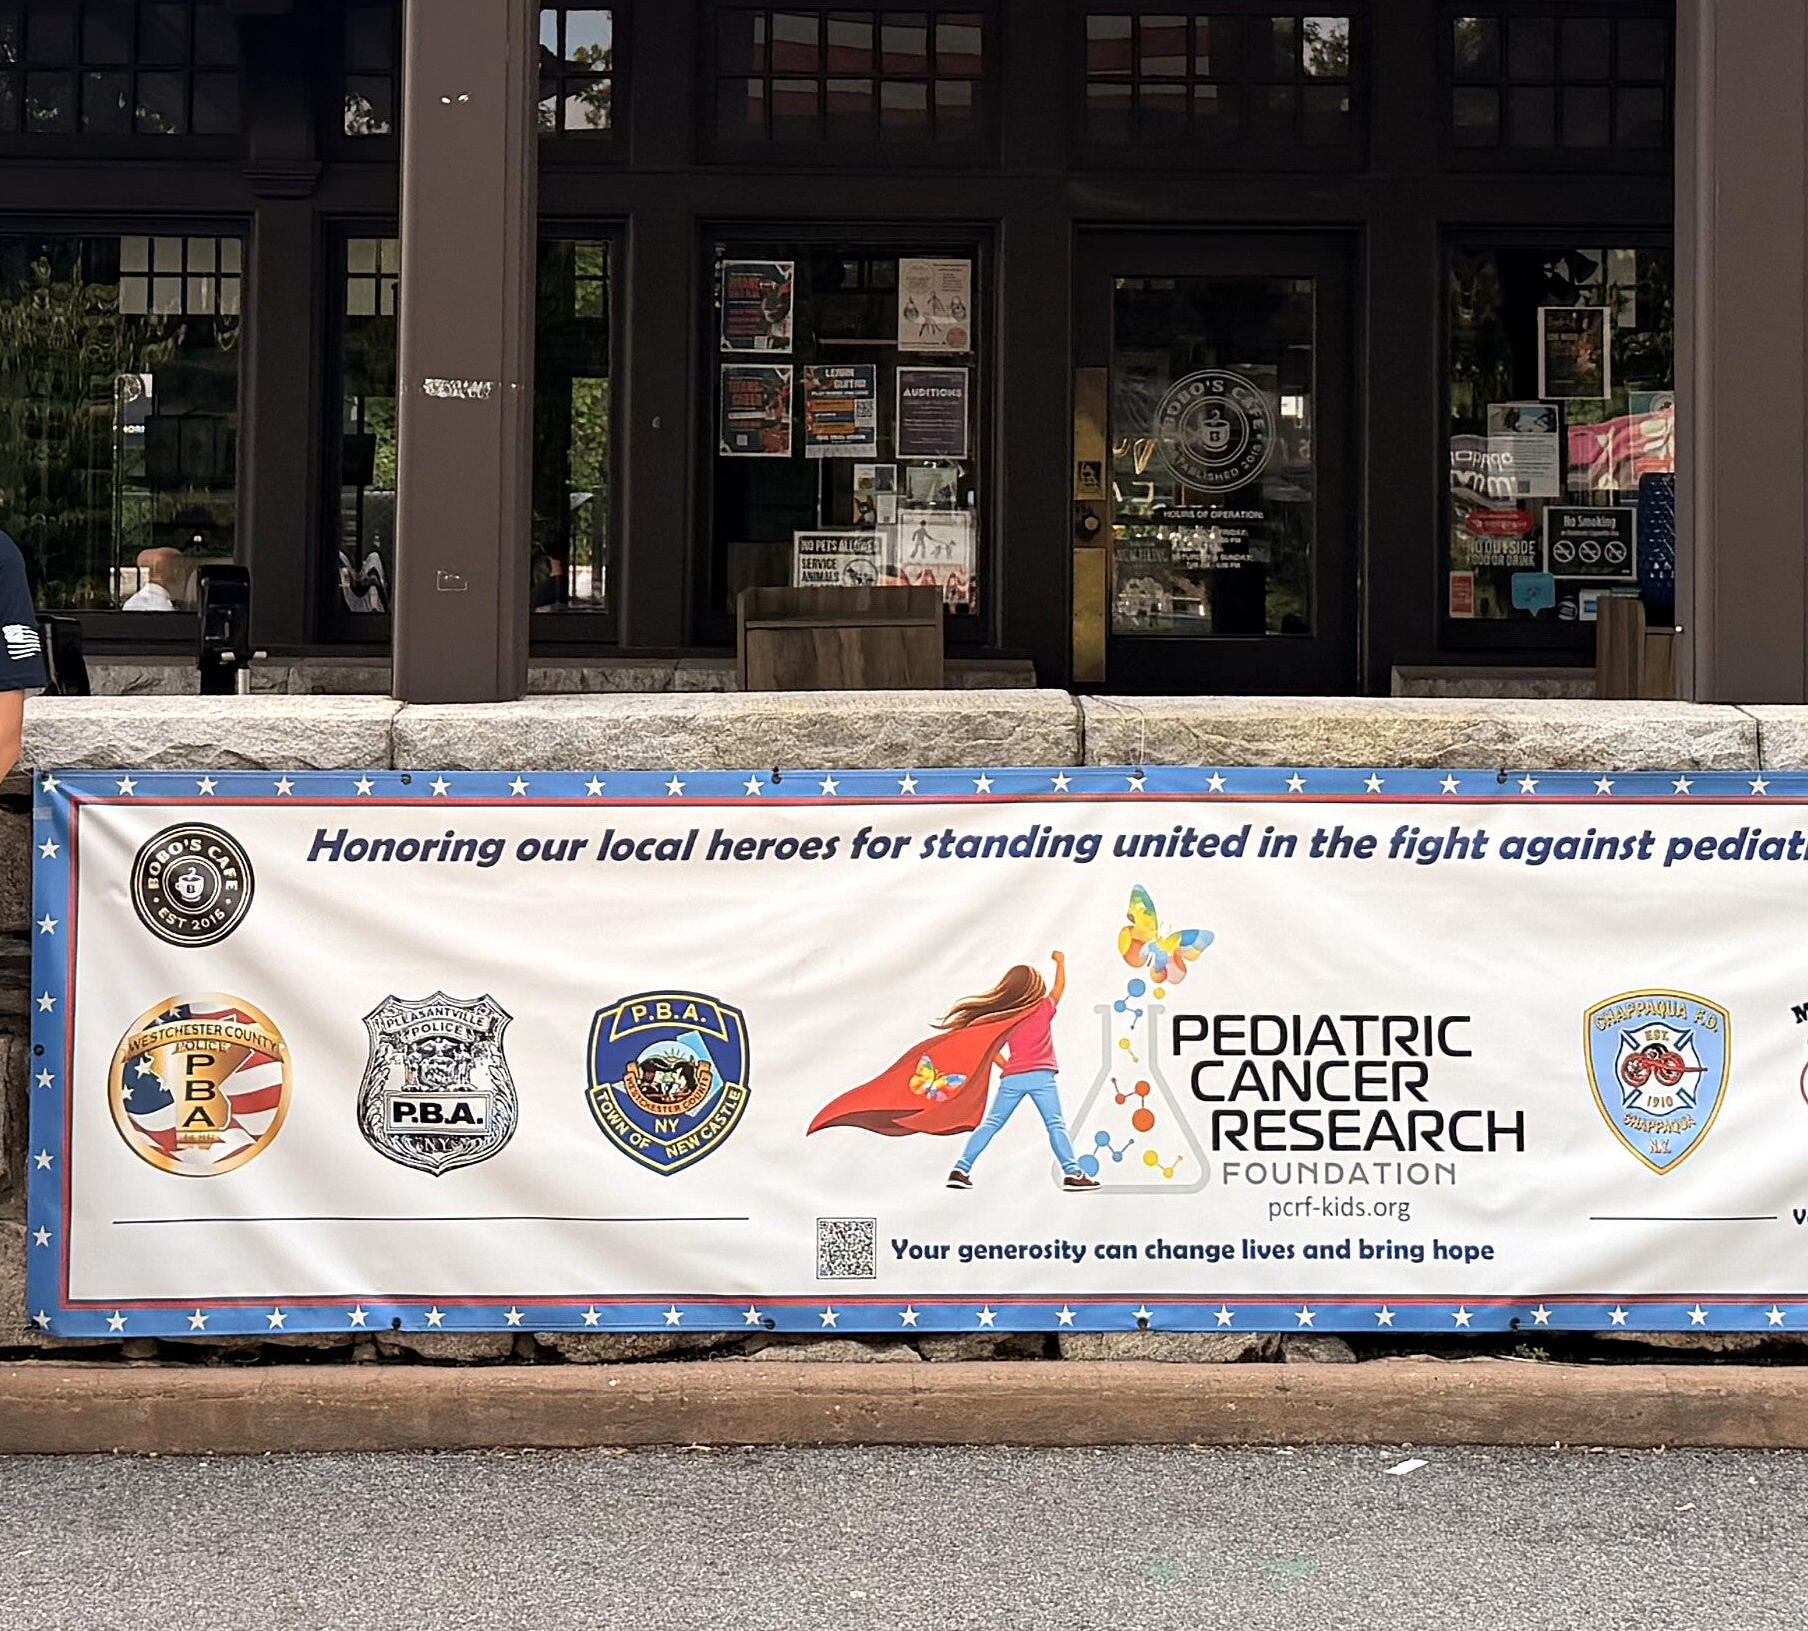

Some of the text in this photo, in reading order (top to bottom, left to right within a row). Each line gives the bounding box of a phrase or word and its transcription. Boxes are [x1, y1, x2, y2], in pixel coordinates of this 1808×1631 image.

[802, 558, 837, 570] SERVICE
[802, 571, 839, 582] ANIMALS
[307, 828, 505, 867] Honoring
[514, 834, 587, 862] our
[595, 829, 695, 862] local
[706, 826, 840, 861] heroes
[849, 827, 911, 860] for
[919, 825, 1097, 864] standing
[1113, 824, 1254, 860] united
[1258, 826, 1296, 859] in
[1309, 825, 1377, 860] the
[1387, 825, 1490, 866] fight
[1498, 828, 1654, 867] against
[148, 838, 238, 891] BOBO'S CAFE
[158, 907, 187, 929] EST
[632, 1002, 707, 1023] P.B.A.
[1594, 999, 1688, 1031] CHAPPAQUA
[128, 1023, 277, 1051] WESTCHESTER COUNTY
[412, 1022, 463, 1037] POLICE
[1172, 1014, 1473, 1057] PEDIATRIC
[1190, 1060, 1429, 1103] CANCER
[392, 1101, 484, 1124] P.B.A.
[1647, 1095, 1674, 1108] 1910
[596, 1090, 741, 1158] TOWN OF NEW CASTLE
[655, 1119, 679, 1133] NY
[1211, 1109, 1524, 1152] RESEARCH
[1222, 1162, 1456, 1185] FOUNDATION
[1268, 1196, 1411, 1222] pcrf-kids.org
[891, 1238, 1496, 1264] Your generosity can change lives and bring hope
